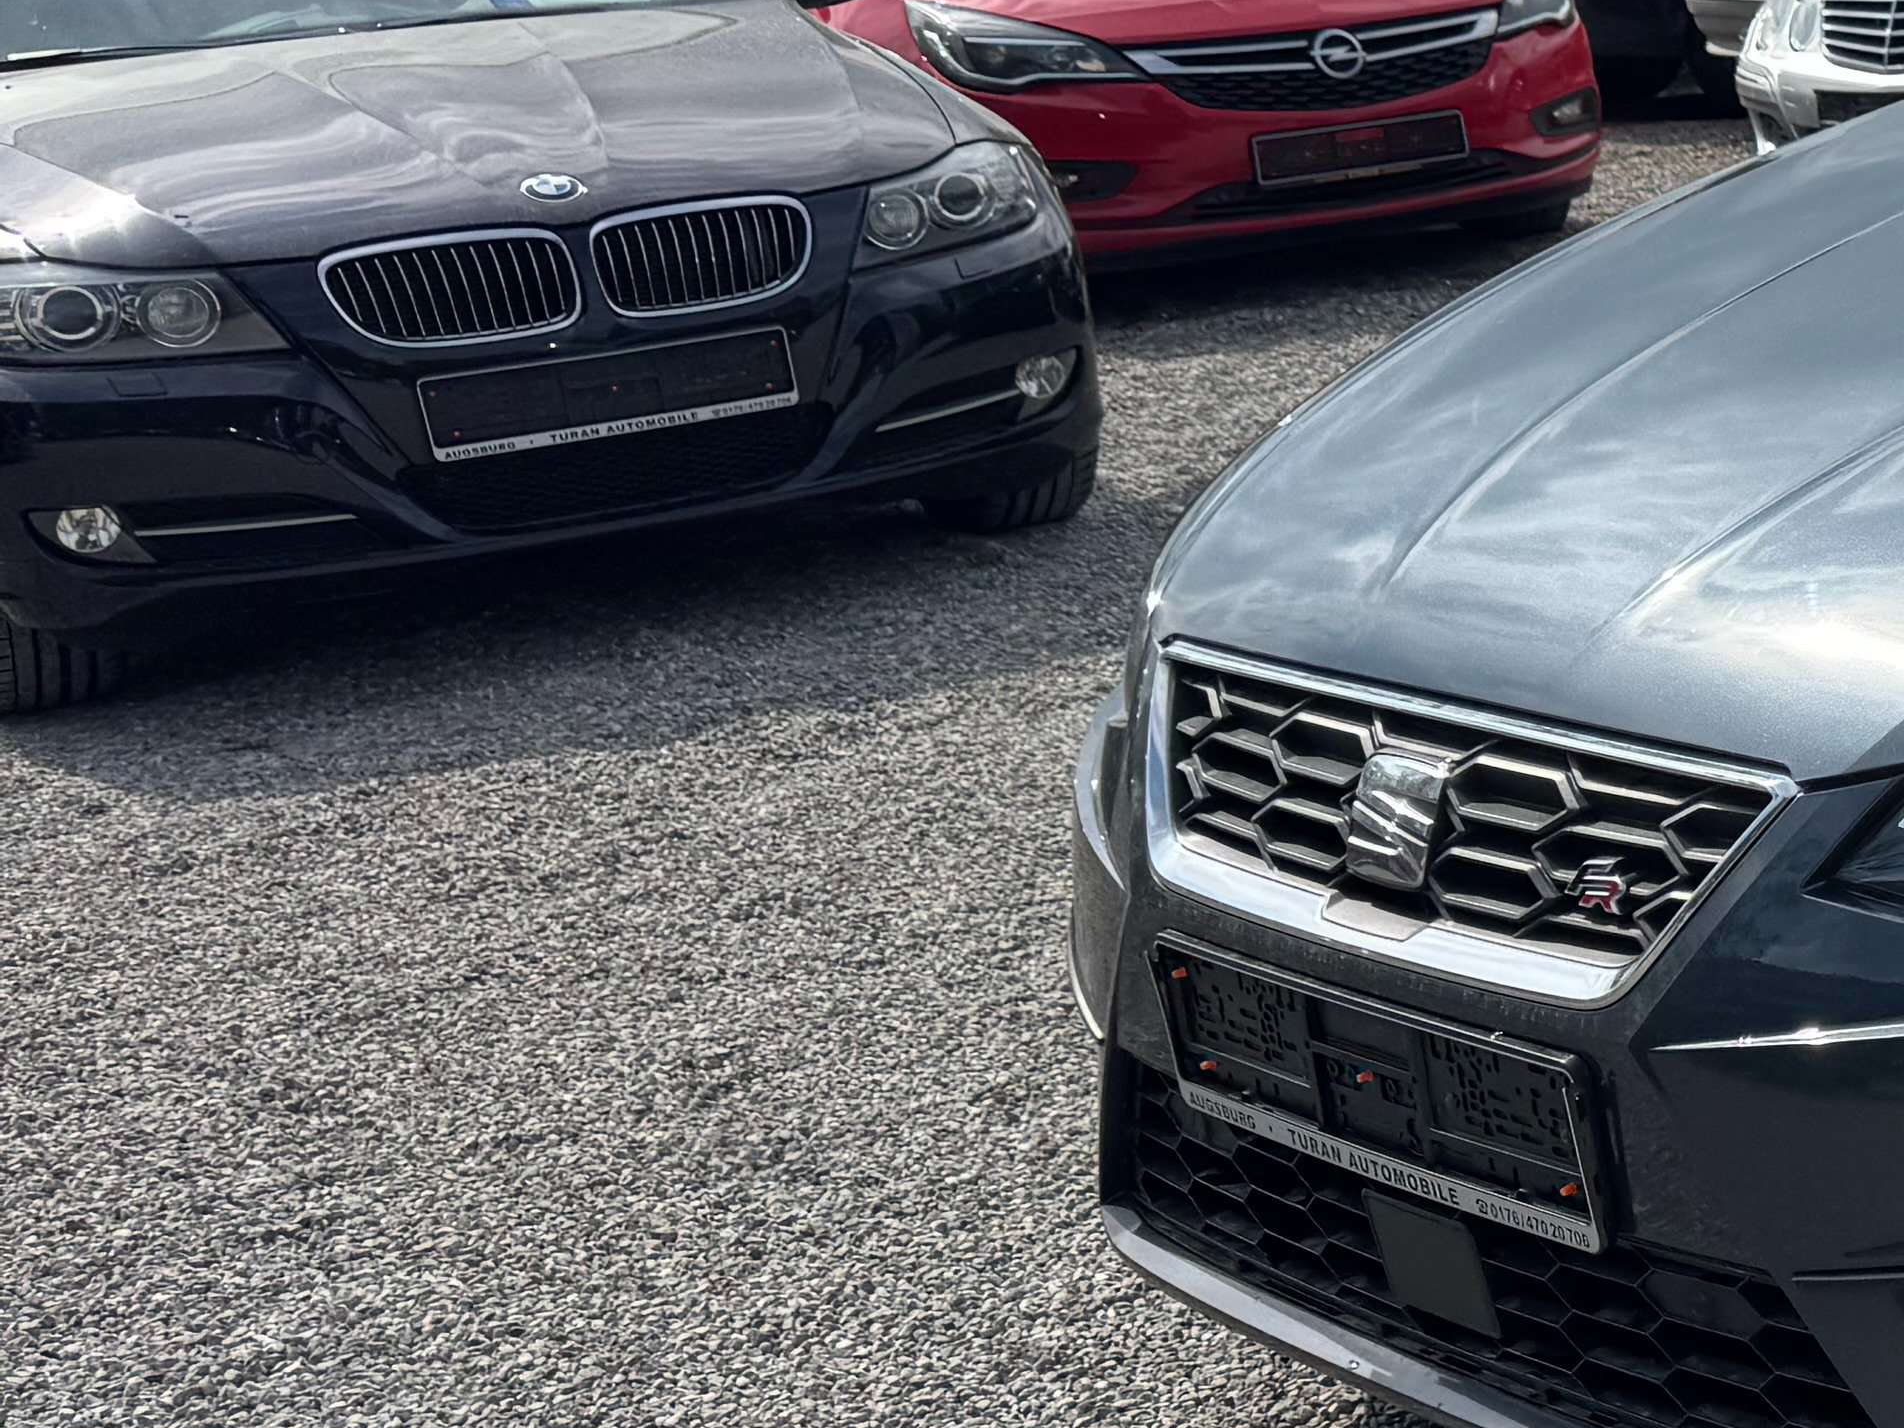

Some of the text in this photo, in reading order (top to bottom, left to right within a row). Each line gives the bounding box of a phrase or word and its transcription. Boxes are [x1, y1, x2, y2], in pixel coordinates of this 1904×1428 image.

[550, 427, 600, 444] TURAN
[607, 411, 699, 434] AUTOMOBILE
[1189, 1091, 1256, 1130] AUGSBURG
[1287, 1128, 1342, 1164] TURAN
[1350, 1149, 1460, 1206] AUTOMOBILE
